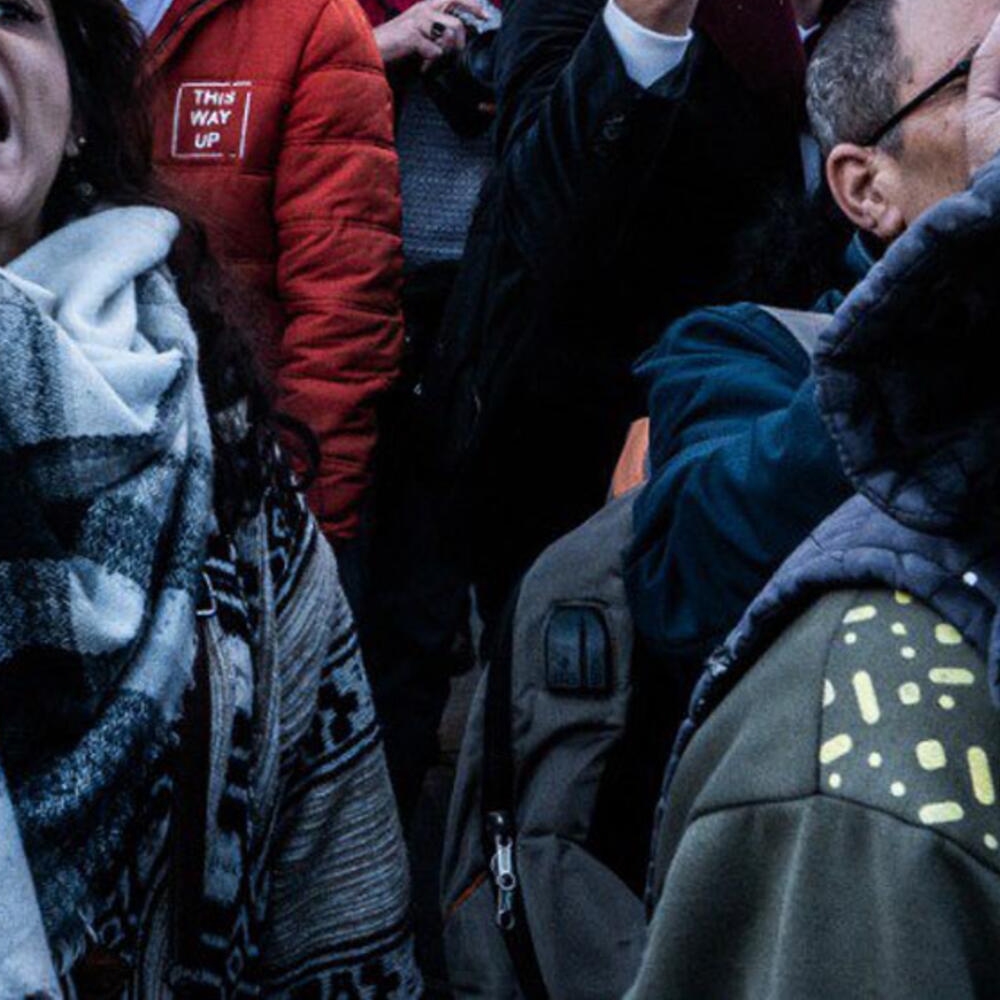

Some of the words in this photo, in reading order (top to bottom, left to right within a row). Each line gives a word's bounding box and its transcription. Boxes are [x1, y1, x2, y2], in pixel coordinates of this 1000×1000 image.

[194, 89, 236, 105] THIS
[190, 110, 232, 126] WAY
[194, 132, 220, 148] UP
